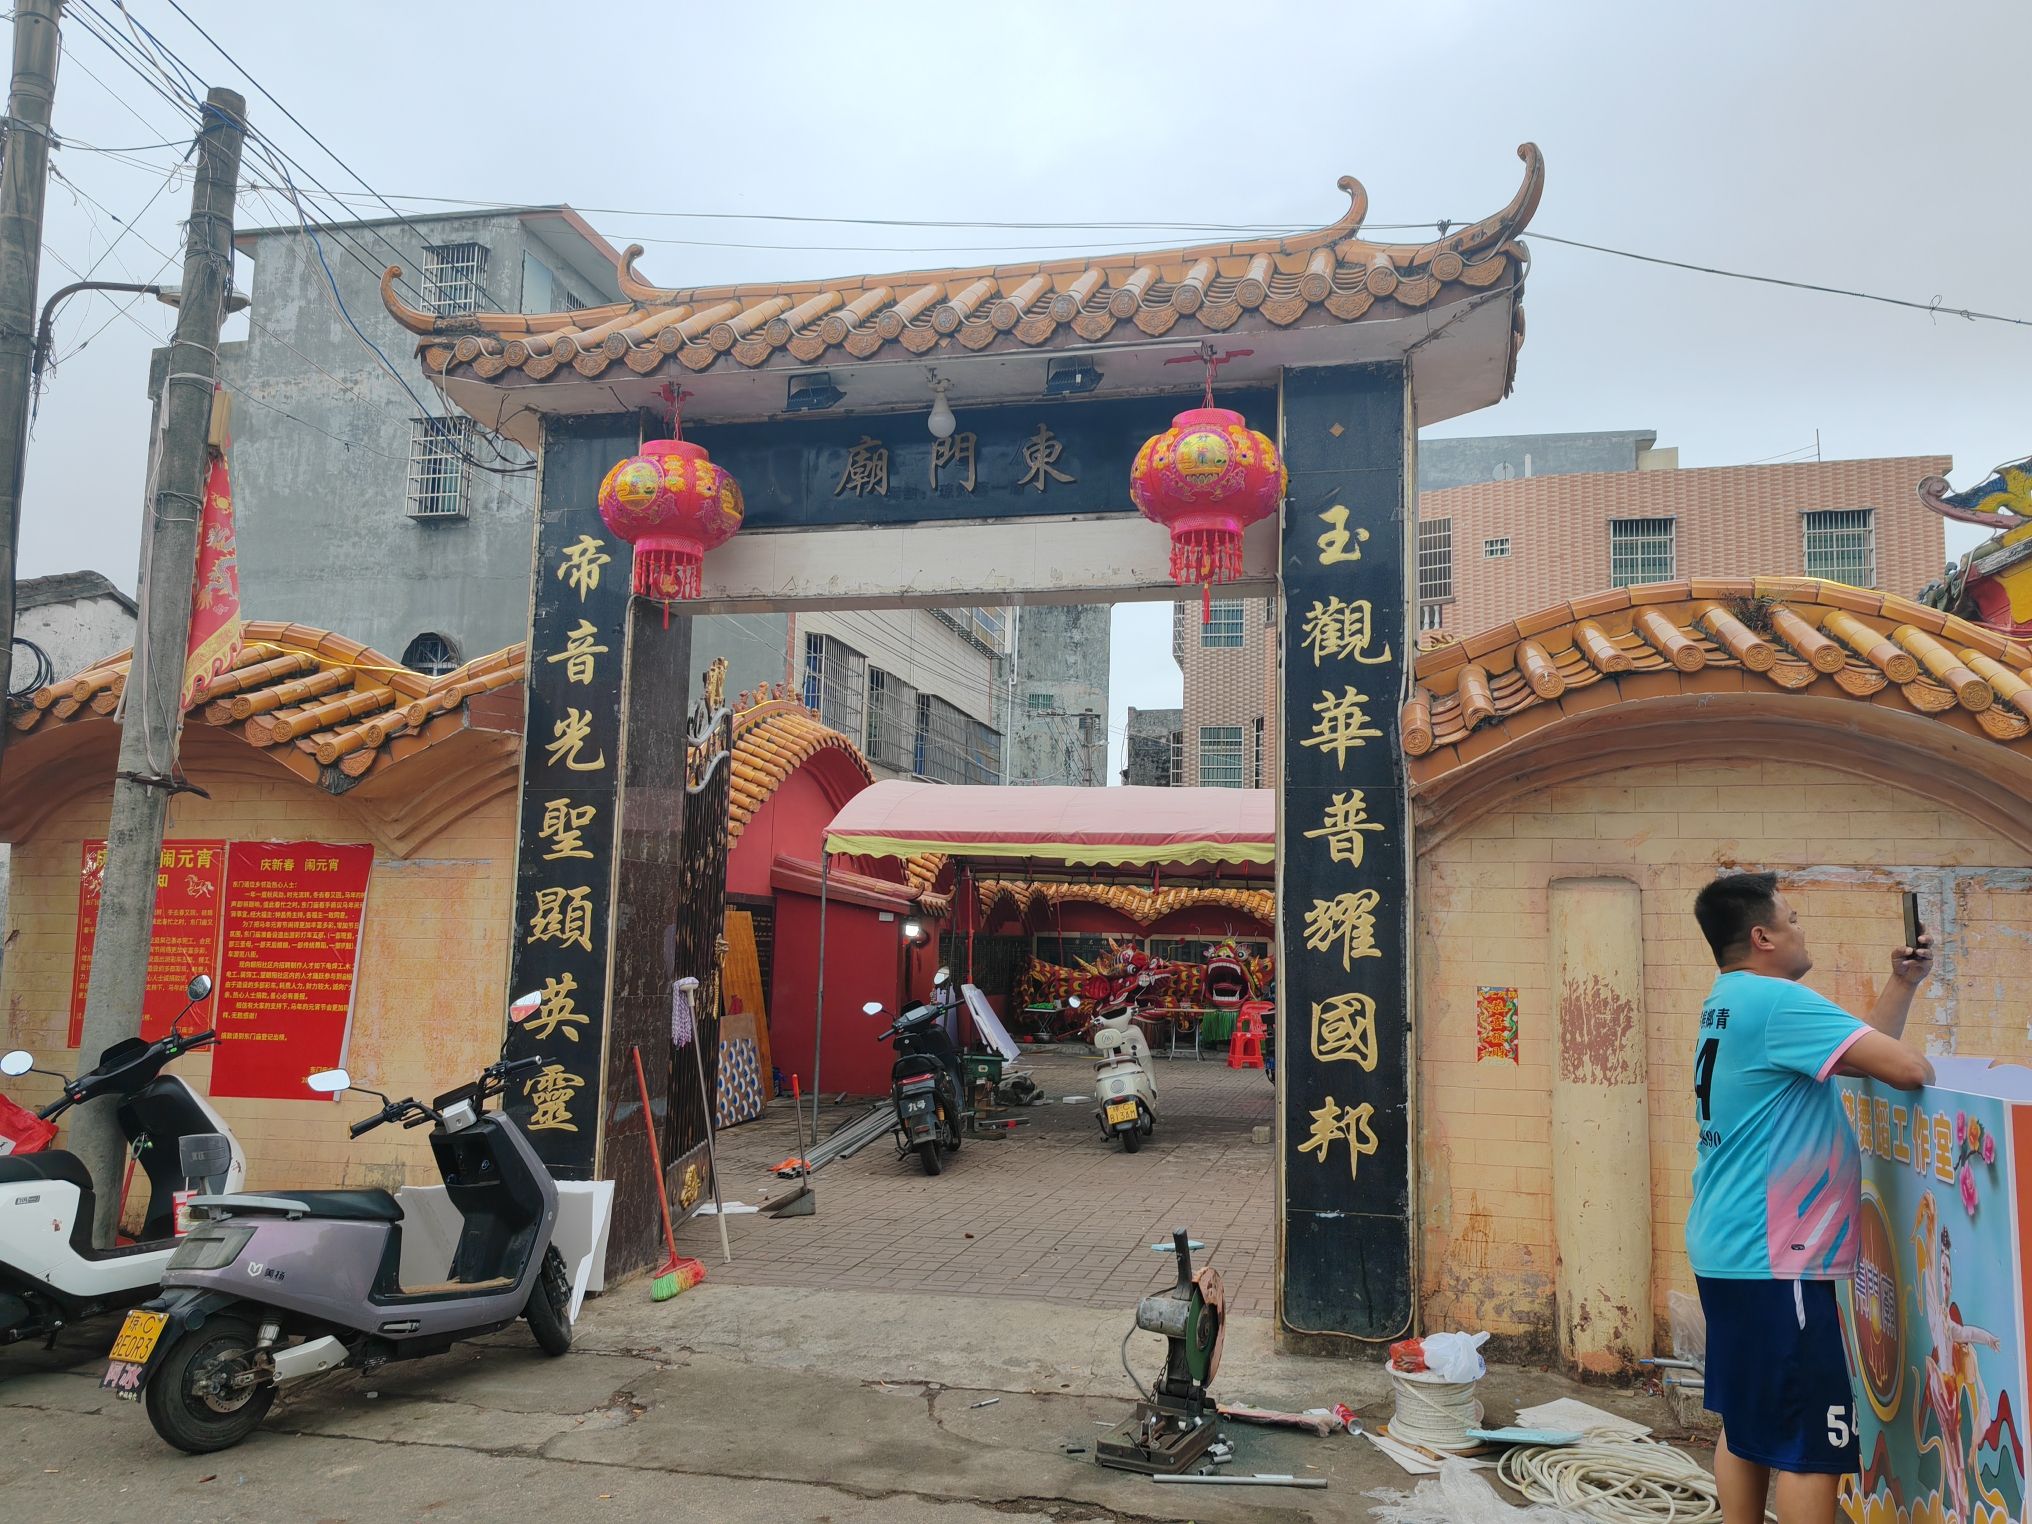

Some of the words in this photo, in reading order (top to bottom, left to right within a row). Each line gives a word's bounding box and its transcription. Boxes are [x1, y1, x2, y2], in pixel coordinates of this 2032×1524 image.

[260, 859, 295, 872] 庆新春
[304, 858, 339, 872] 闹元宵
